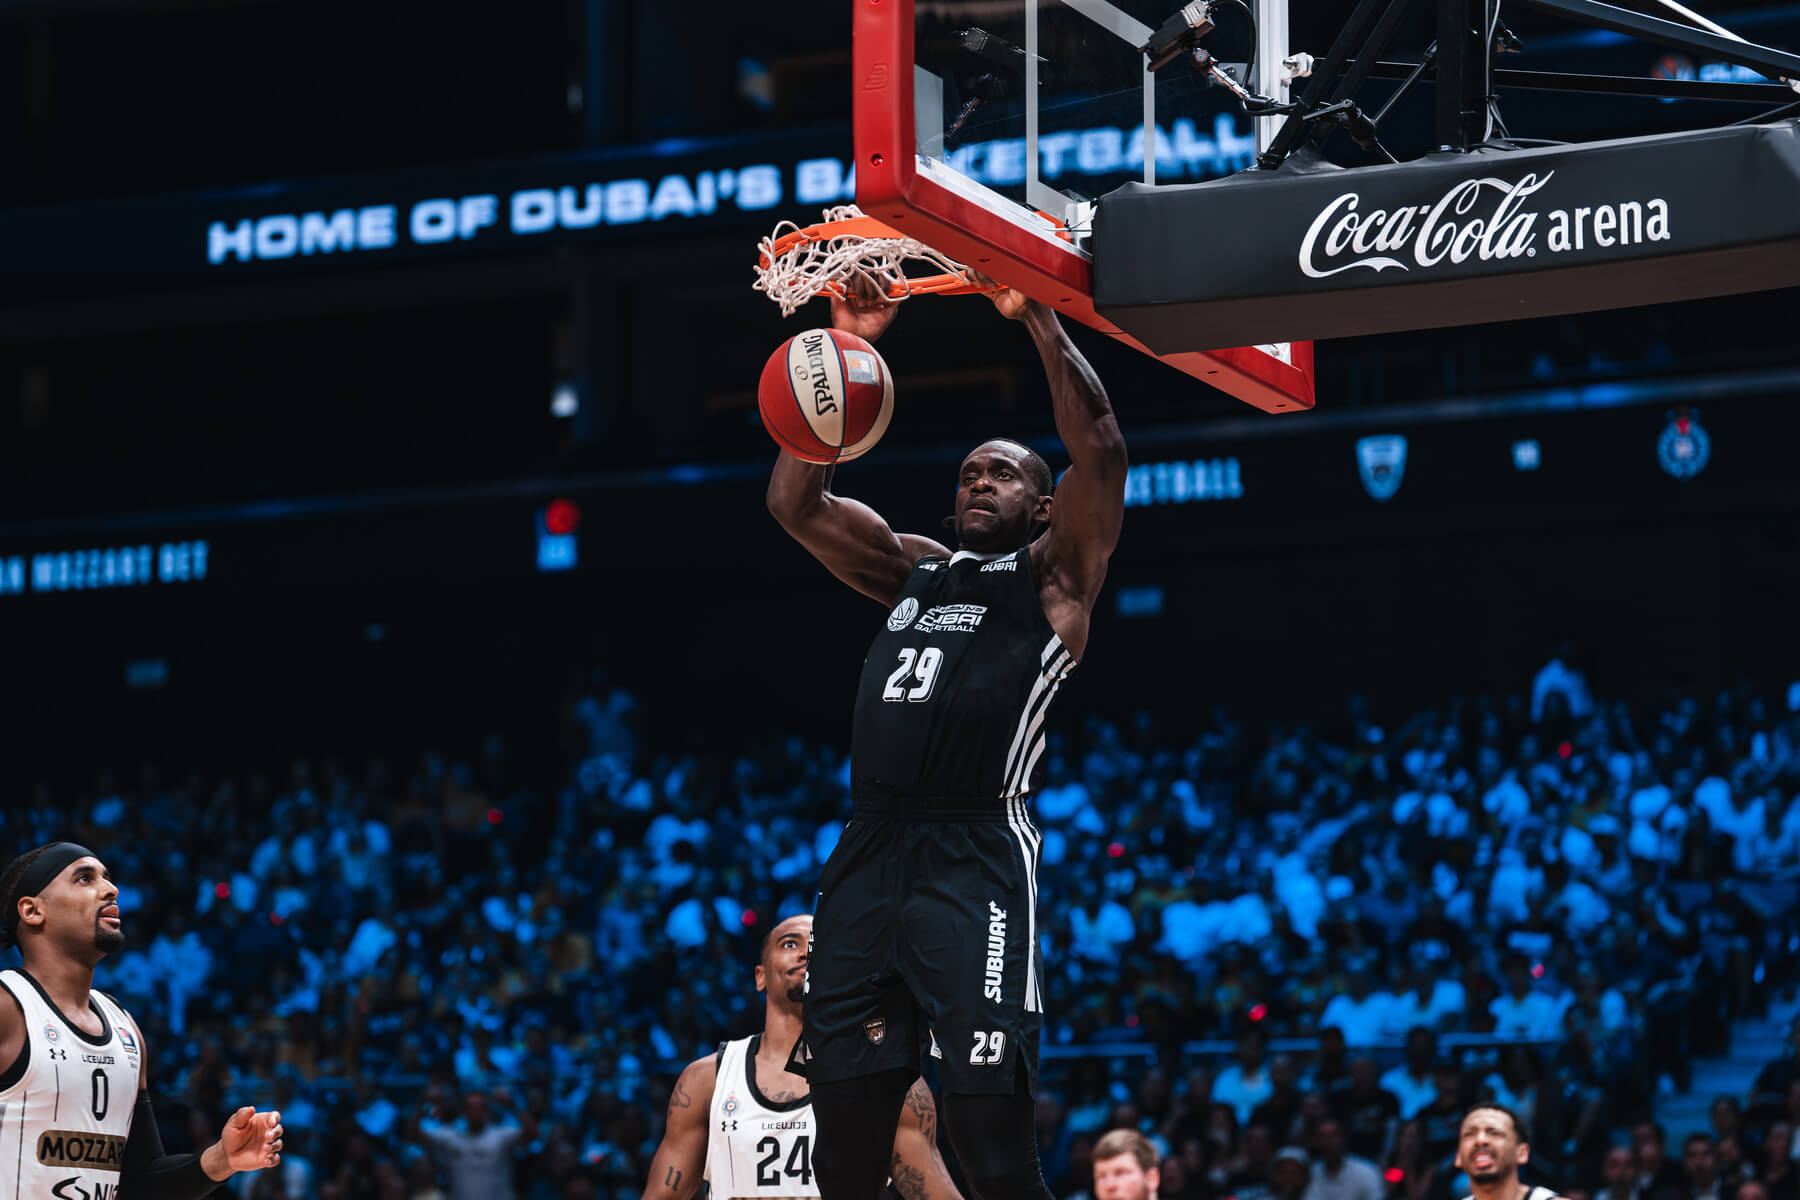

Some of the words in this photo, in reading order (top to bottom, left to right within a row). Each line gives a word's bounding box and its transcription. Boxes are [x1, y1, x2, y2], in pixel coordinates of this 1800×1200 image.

[207, 203, 398, 265] HOME
[409, 193, 499, 244] OF
[510, 163, 783, 235] DUBAI'S
[1547, 197, 1671, 252] arena
[802, 334, 839, 417] SPALDING
[31, 544, 153, 593] MOZZART
[158, 538, 210, 585] BET
[979, 560, 1018, 573] DUBAI
[882, 646, 944, 703] 29
[983, 899, 1009, 1005] SUBWAY
[969, 1030, 1007, 1066] 29
[91, 1067, 109, 1122] 0
[756, 1135, 812, 1187] 24
